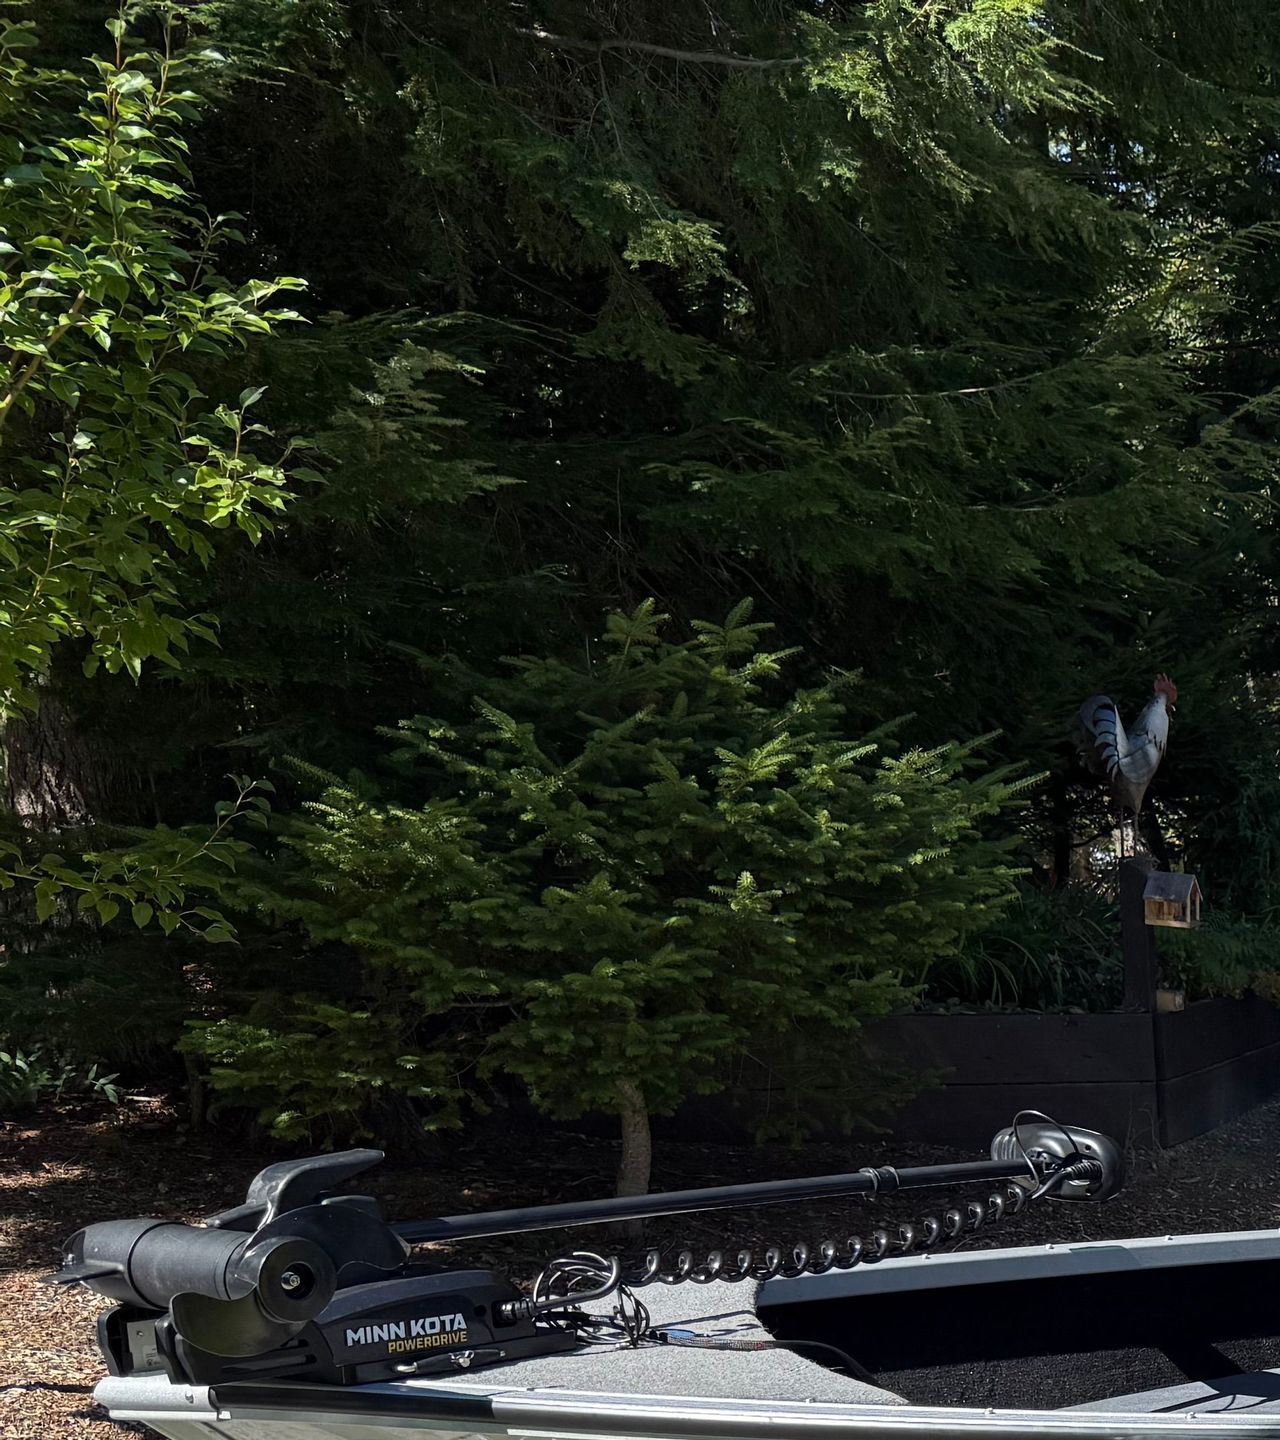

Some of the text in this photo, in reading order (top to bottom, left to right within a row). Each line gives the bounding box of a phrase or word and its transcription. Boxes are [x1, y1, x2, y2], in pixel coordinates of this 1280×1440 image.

[346, 1312, 468, 1347] MINN KOTA
[387, 1330, 468, 1354] POWERDRIVE
